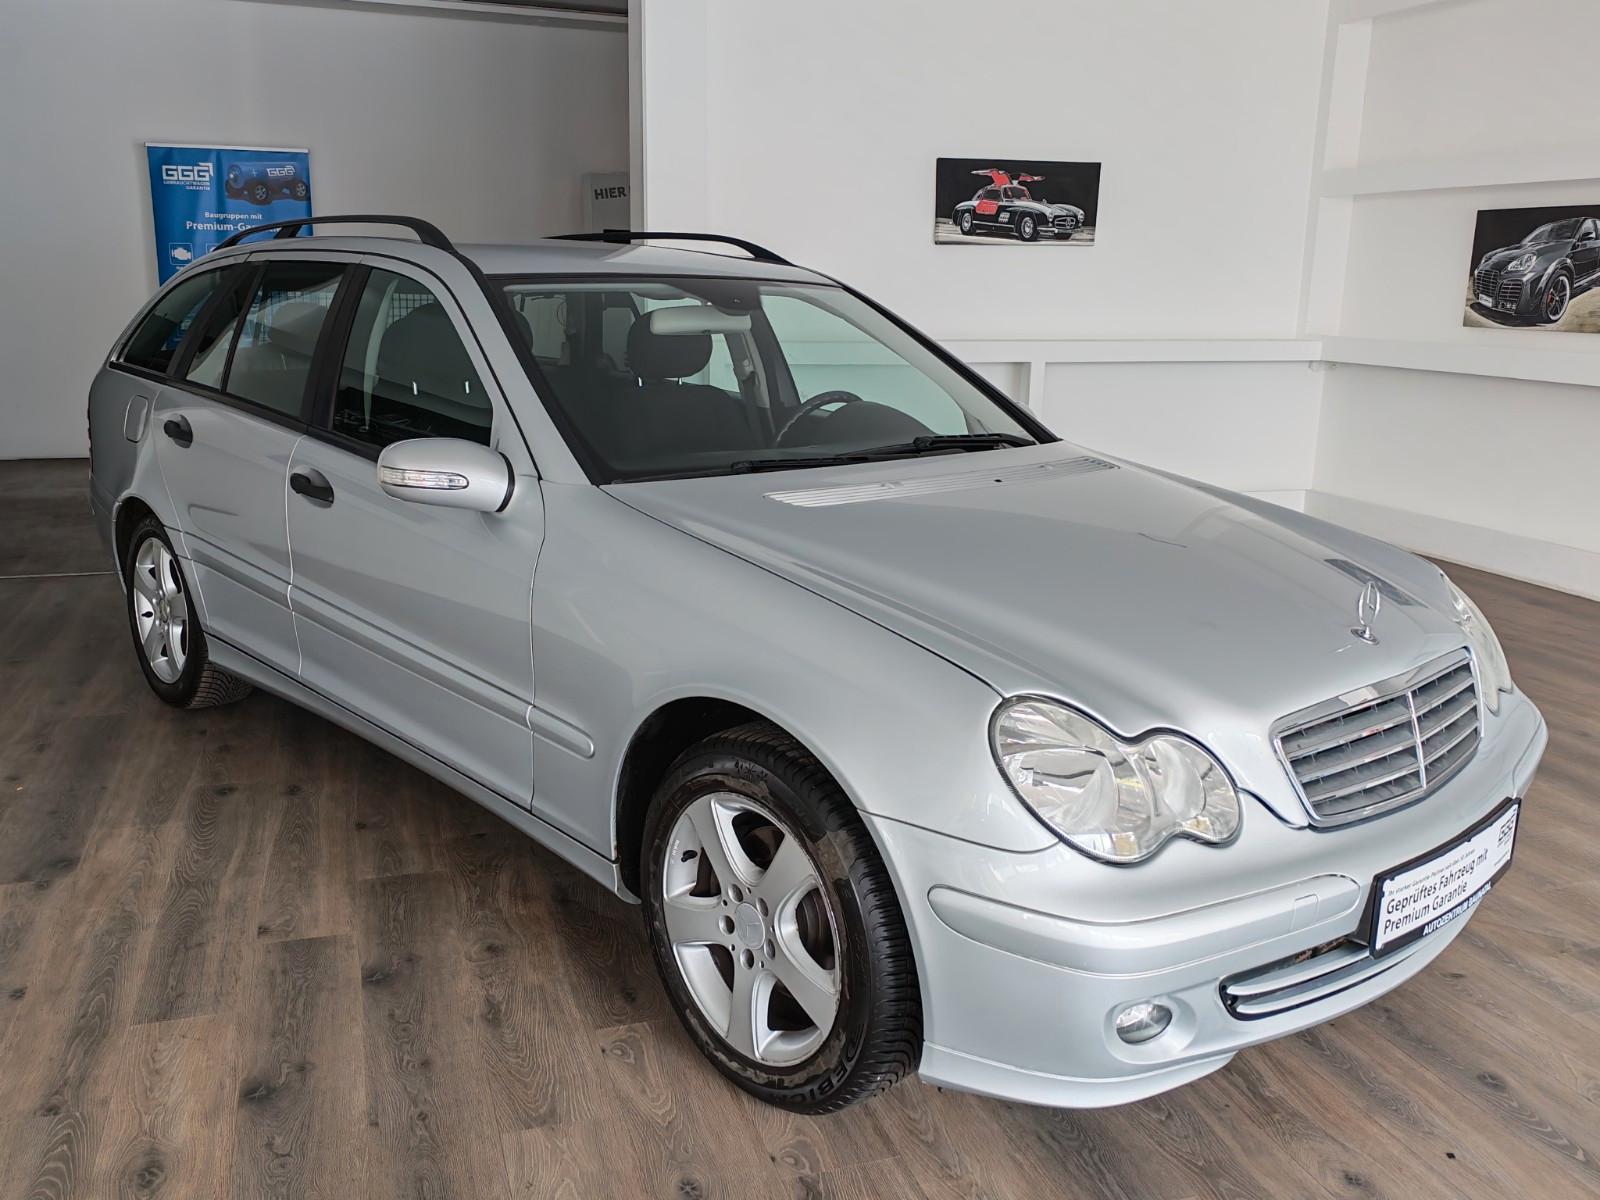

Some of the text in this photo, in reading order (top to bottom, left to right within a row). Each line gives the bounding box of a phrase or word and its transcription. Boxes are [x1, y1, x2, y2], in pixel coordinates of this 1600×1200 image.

[162, 163, 213, 181] GGG
[266, 165, 295, 176] GGG
[594, 186, 626, 200] HIER
[204, 211, 249, 221] Baugruppen
[1386, 882, 1437, 915] Geprüftes
[1439, 860, 1475, 891] Fahrzeug
[1476, 848, 1488, 867] mit
[1384, 904, 1430, 935] Premium
[1432, 879, 1467, 911] Garantie
